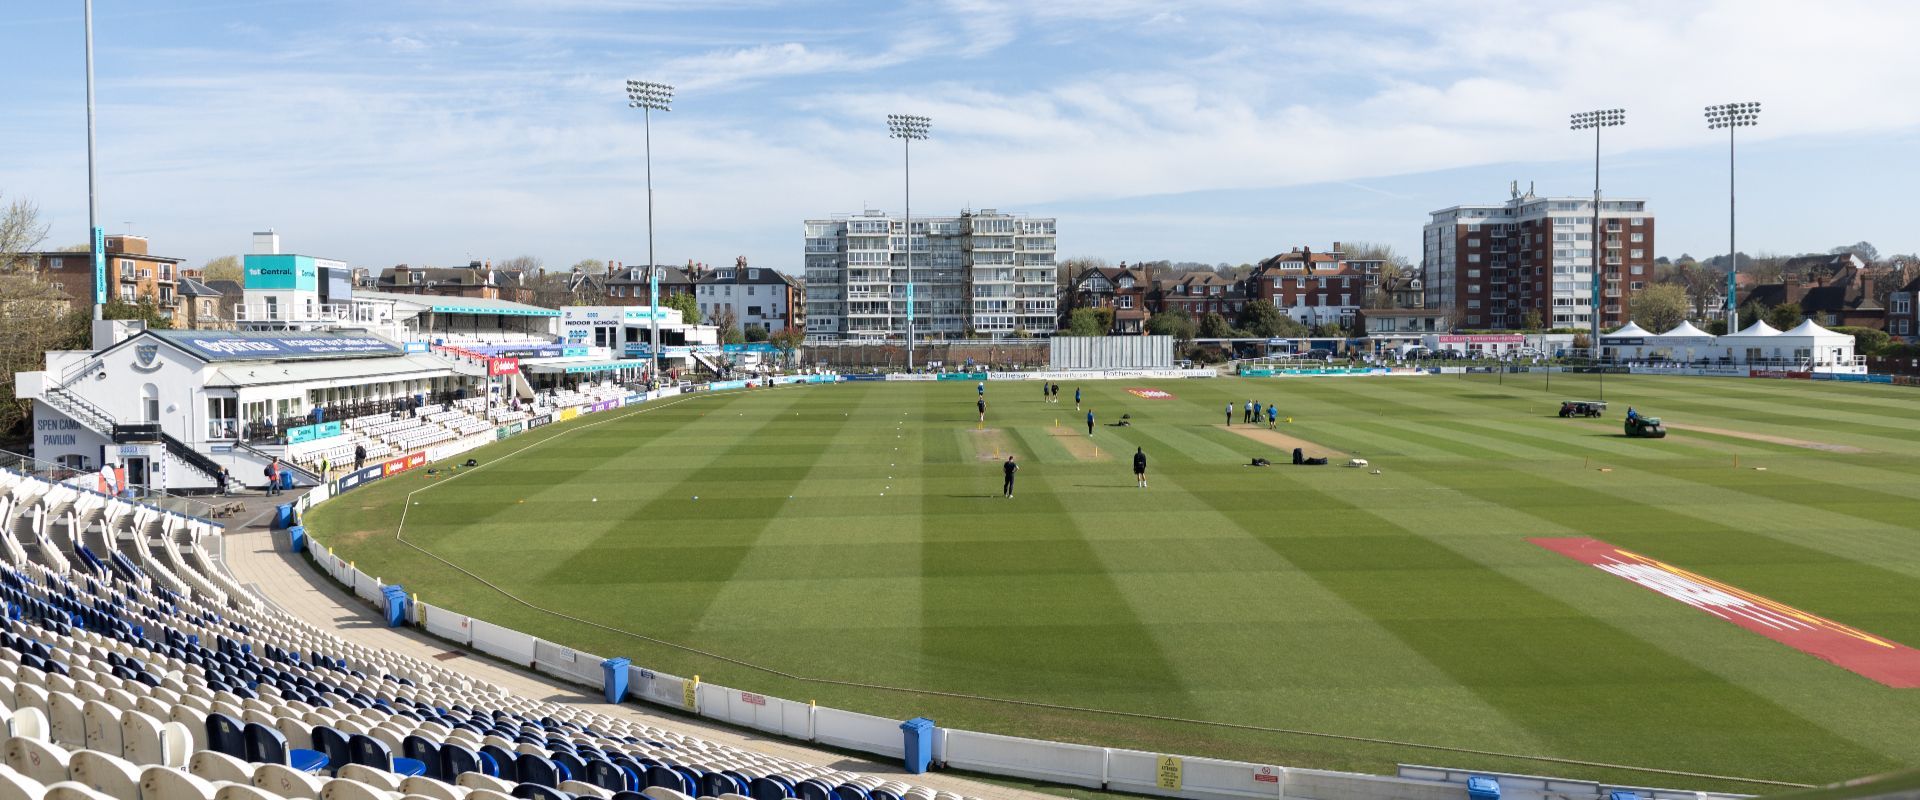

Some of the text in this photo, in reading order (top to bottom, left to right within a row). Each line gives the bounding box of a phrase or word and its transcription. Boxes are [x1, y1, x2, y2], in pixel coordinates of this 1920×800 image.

[38, 420, 81, 430] SPEN CAMA
[44, 434, 76, 446] PAVILION
